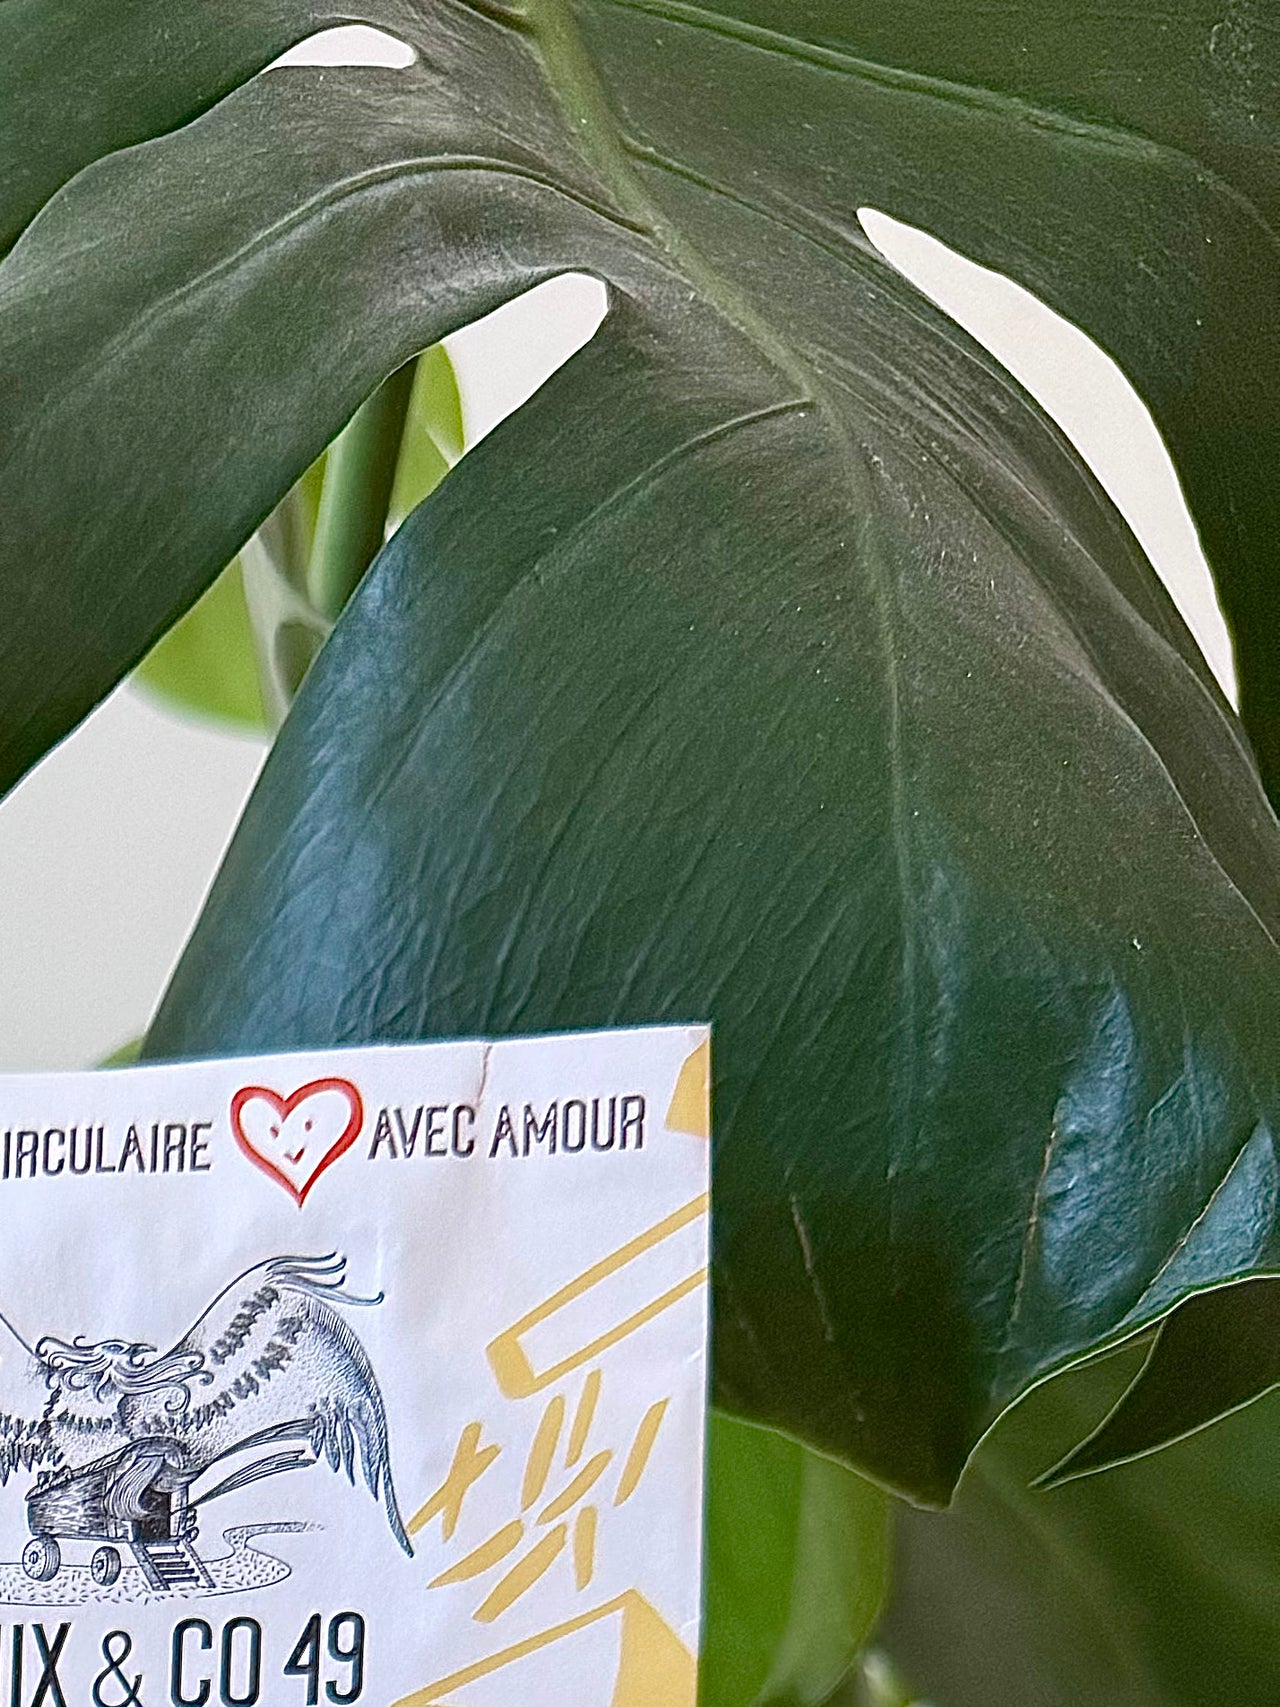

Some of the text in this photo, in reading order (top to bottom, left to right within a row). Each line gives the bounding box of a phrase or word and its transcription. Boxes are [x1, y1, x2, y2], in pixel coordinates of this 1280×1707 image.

[368, 1094, 647, 1160] AVEC AMOUR
[284, 1611, 366, 1706] 49
